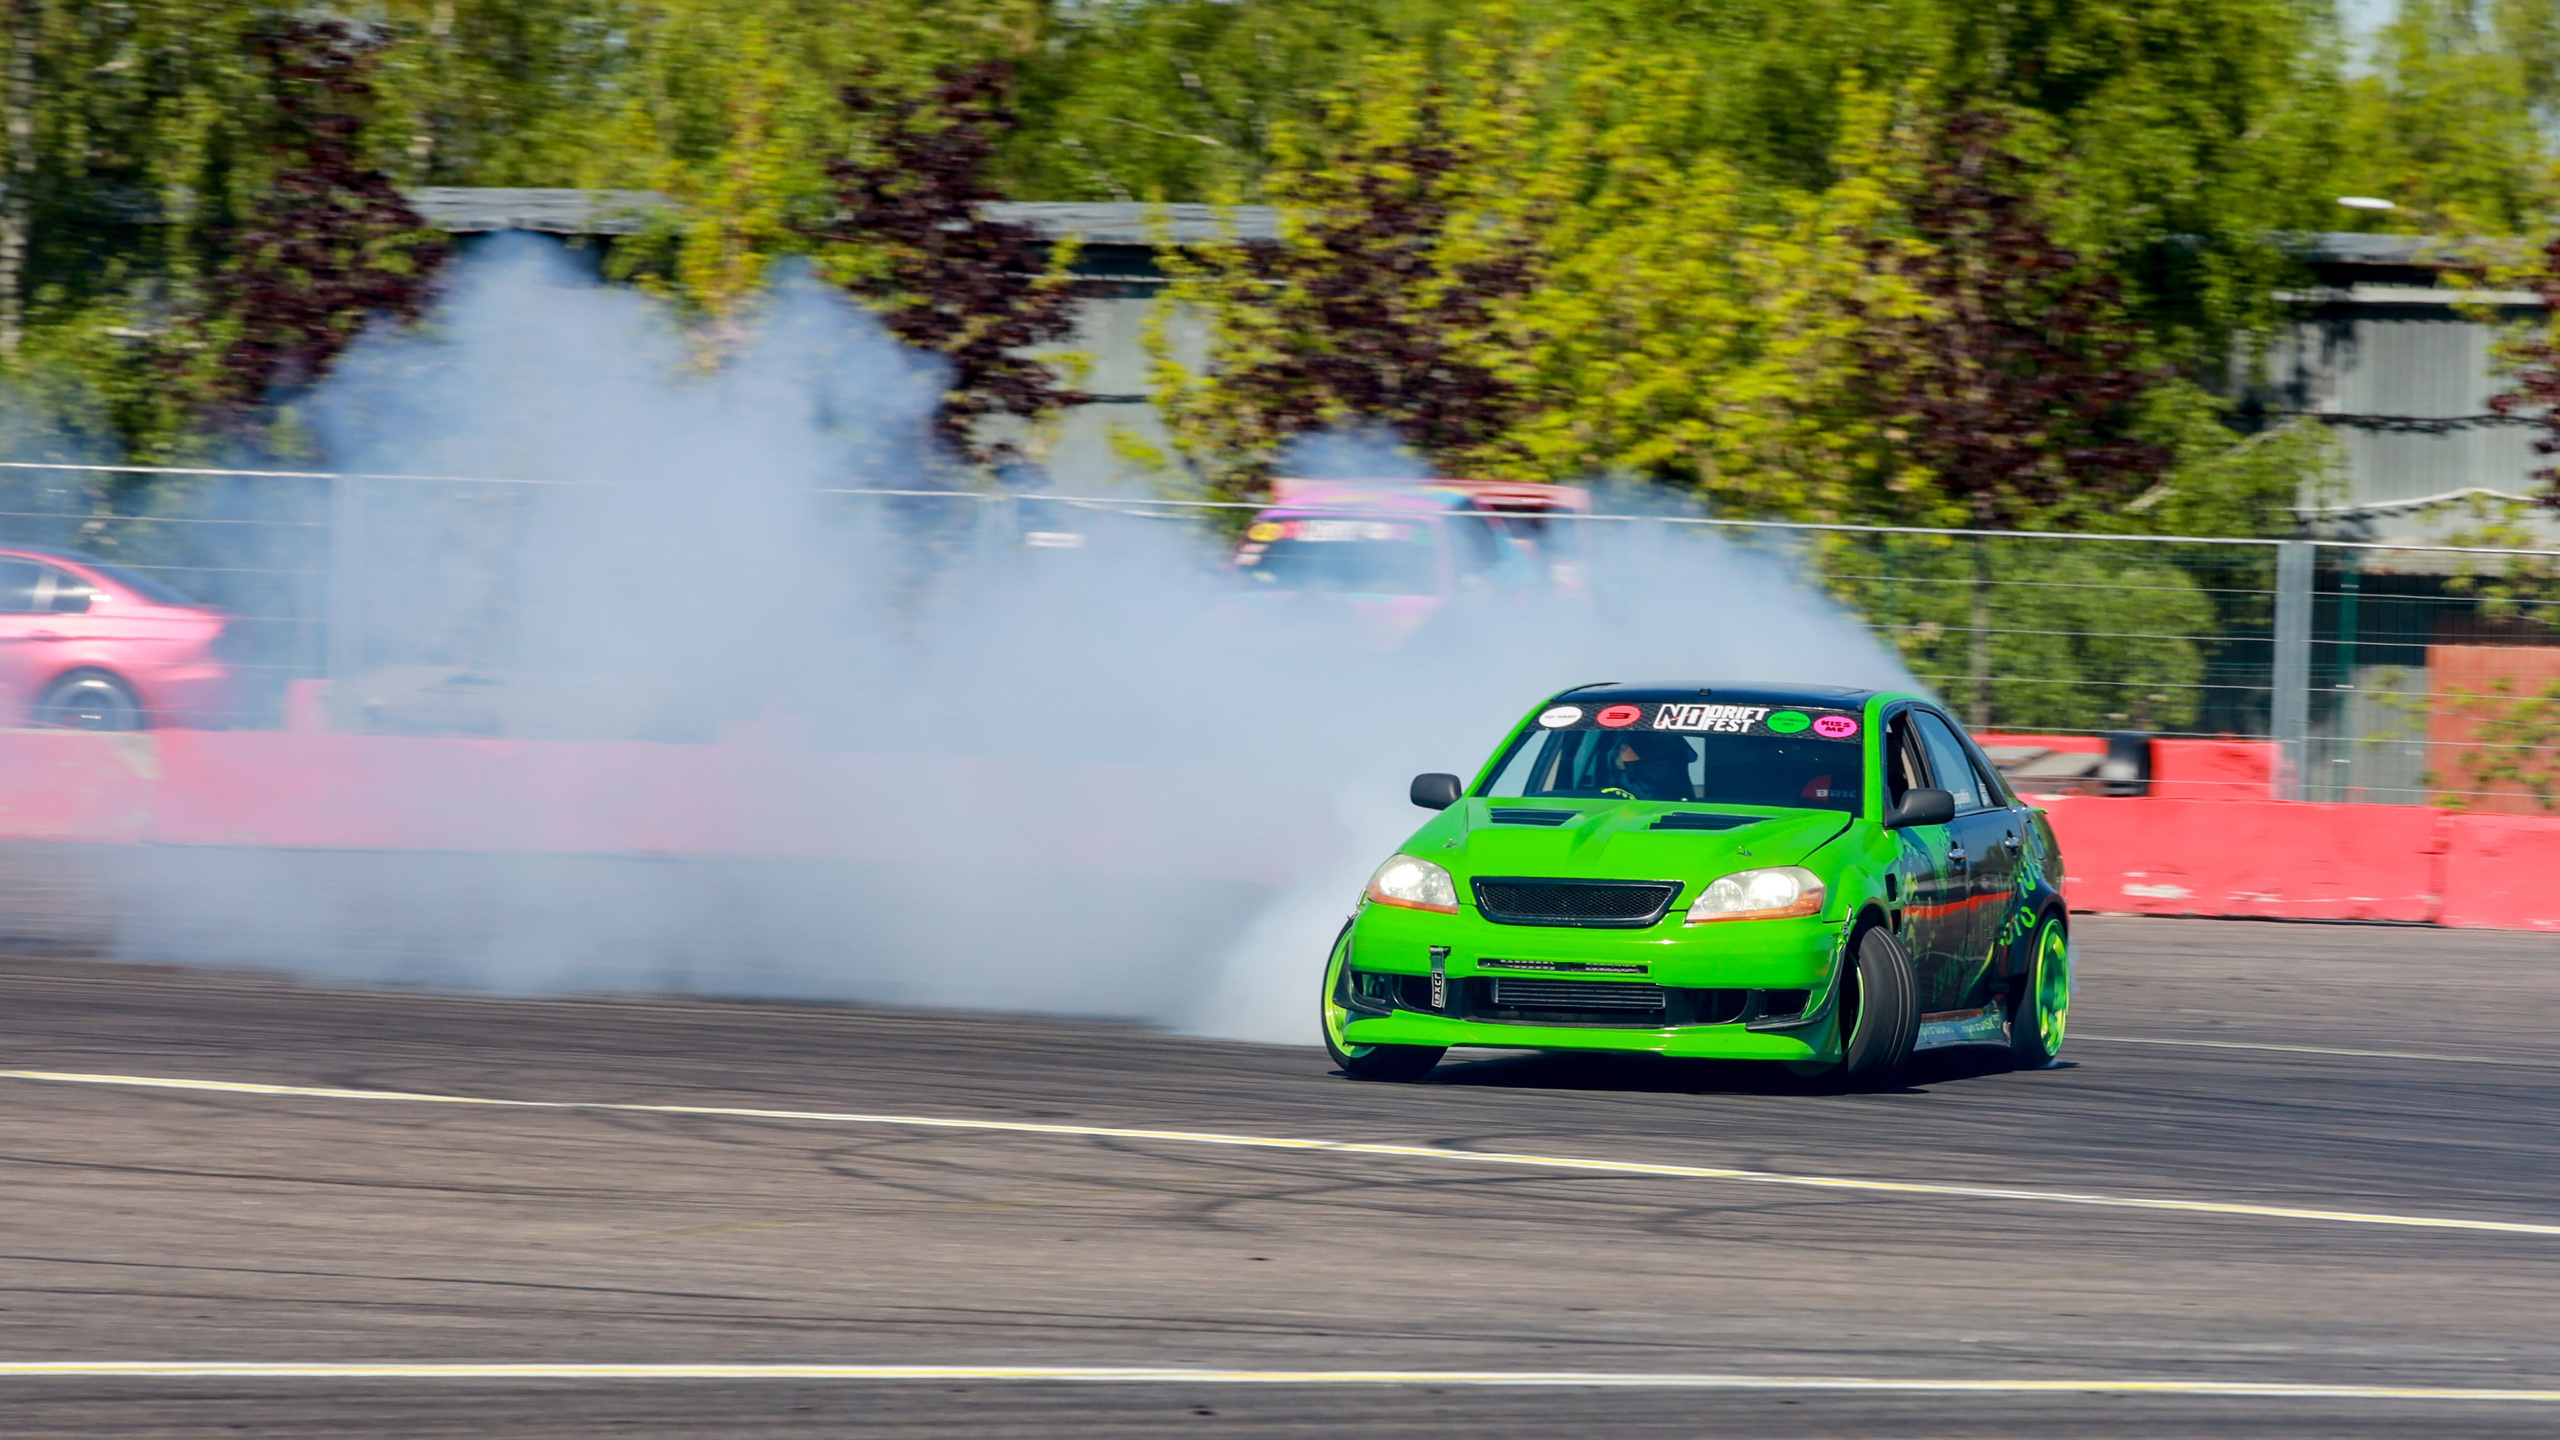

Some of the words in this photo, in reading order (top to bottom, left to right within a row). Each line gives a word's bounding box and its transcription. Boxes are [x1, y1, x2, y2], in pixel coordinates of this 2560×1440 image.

[1707, 705, 1770, 720] DRIFT
[1703, 718, 1755, 733] FEST
[1820, 720, 1850, 728] KISS
